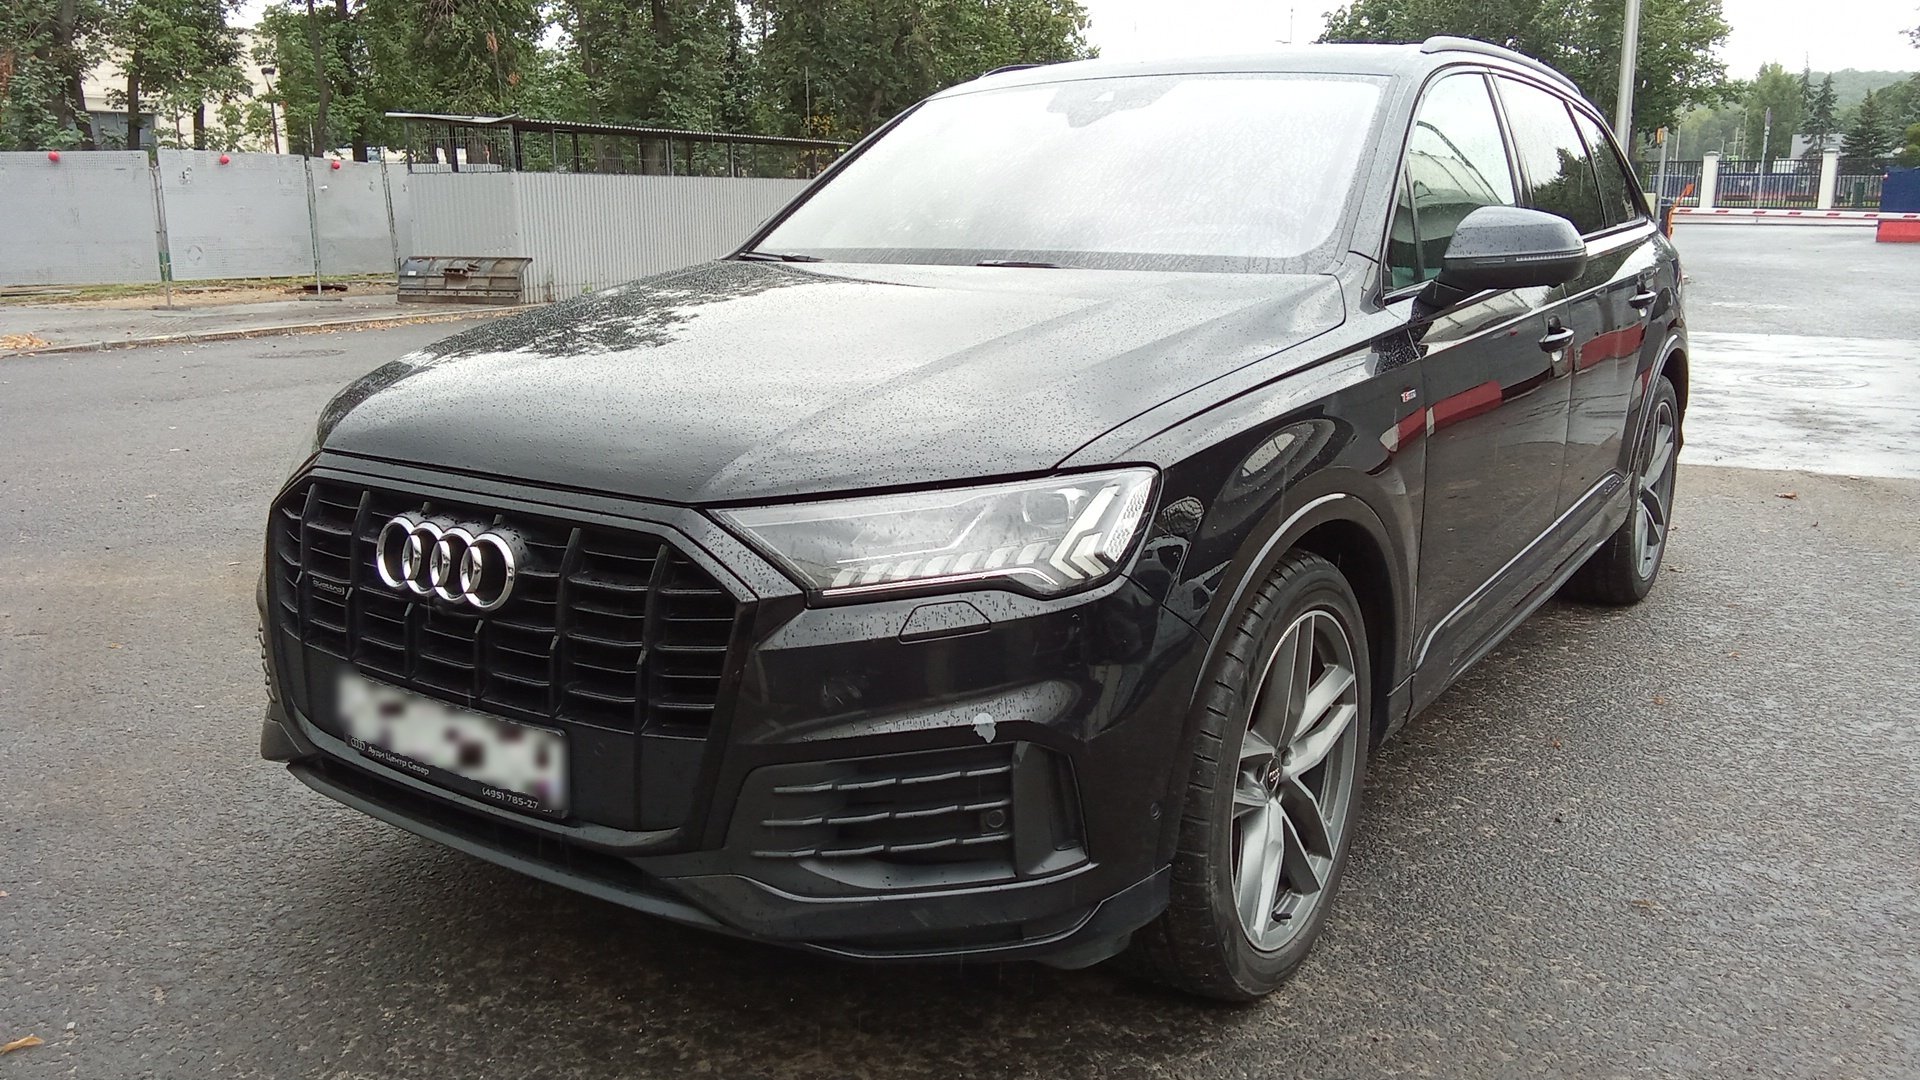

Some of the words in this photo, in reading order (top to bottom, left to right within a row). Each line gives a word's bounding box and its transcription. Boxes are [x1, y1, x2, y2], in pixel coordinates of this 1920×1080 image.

[368, 746, 385, 759] Ауди
[385, 753, 407, 768] Центр
[407, 761, 430, 776] Север
[482, 787, 505, 801] (495)
[506, 794, 552, 812] 785-27
